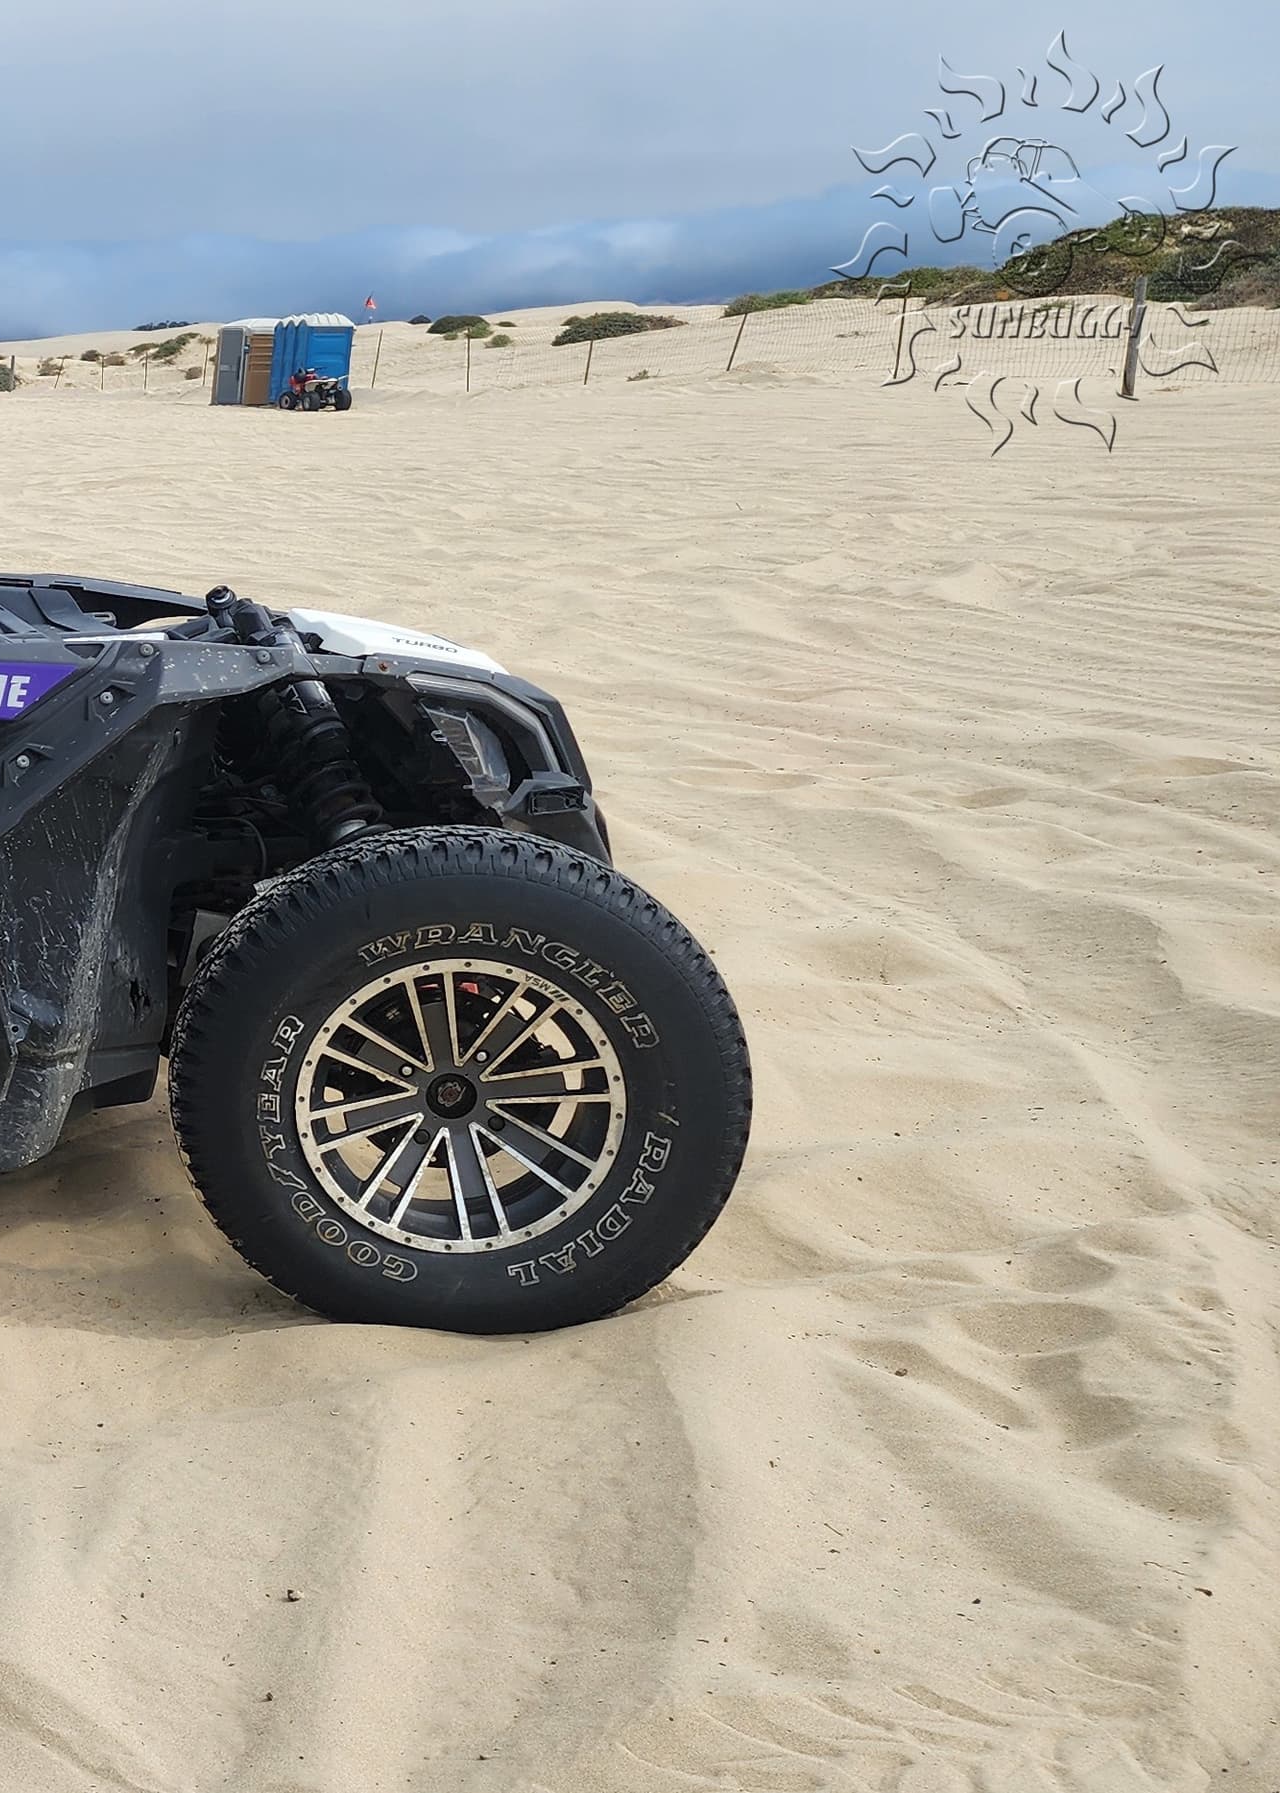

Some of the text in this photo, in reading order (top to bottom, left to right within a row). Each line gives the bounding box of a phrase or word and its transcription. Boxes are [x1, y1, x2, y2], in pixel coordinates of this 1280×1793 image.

[391, 636, 459, 654] TURBO
[357, 922, 661, 1049] WRANGLER
[256, 1014, 419, 1283] GOODYEAR
[507, 1132, 672, 1287] RADIAL
